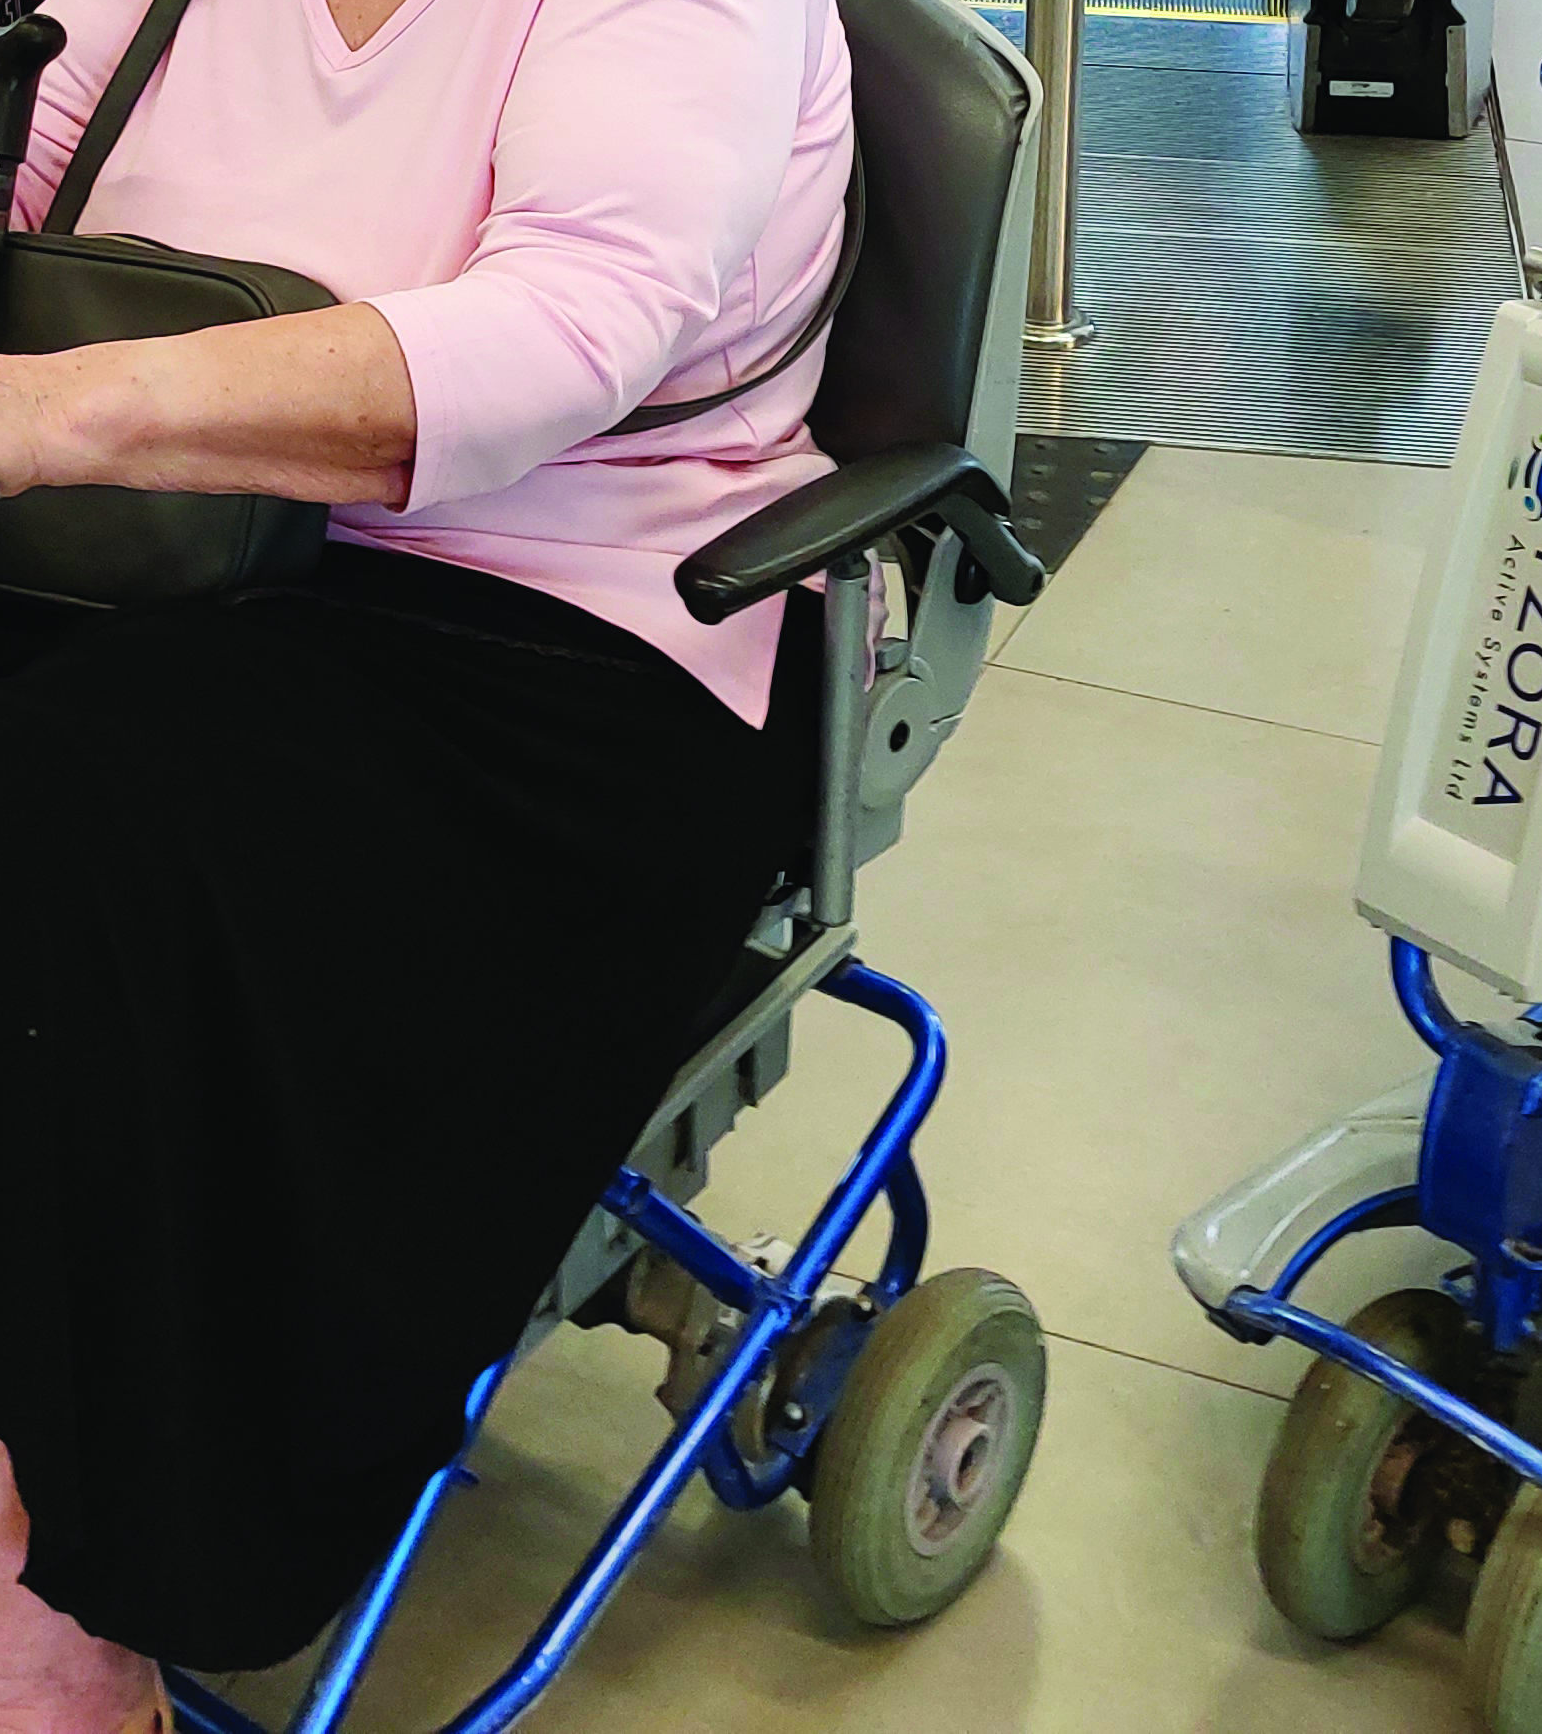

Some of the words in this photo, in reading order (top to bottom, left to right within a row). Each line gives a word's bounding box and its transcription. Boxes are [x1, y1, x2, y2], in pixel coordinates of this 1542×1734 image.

[1490, 533, 1527, 622] Active
[1459, 636, 1502, 744] Systems
[1444, 757, 1473, 801] Ltd
